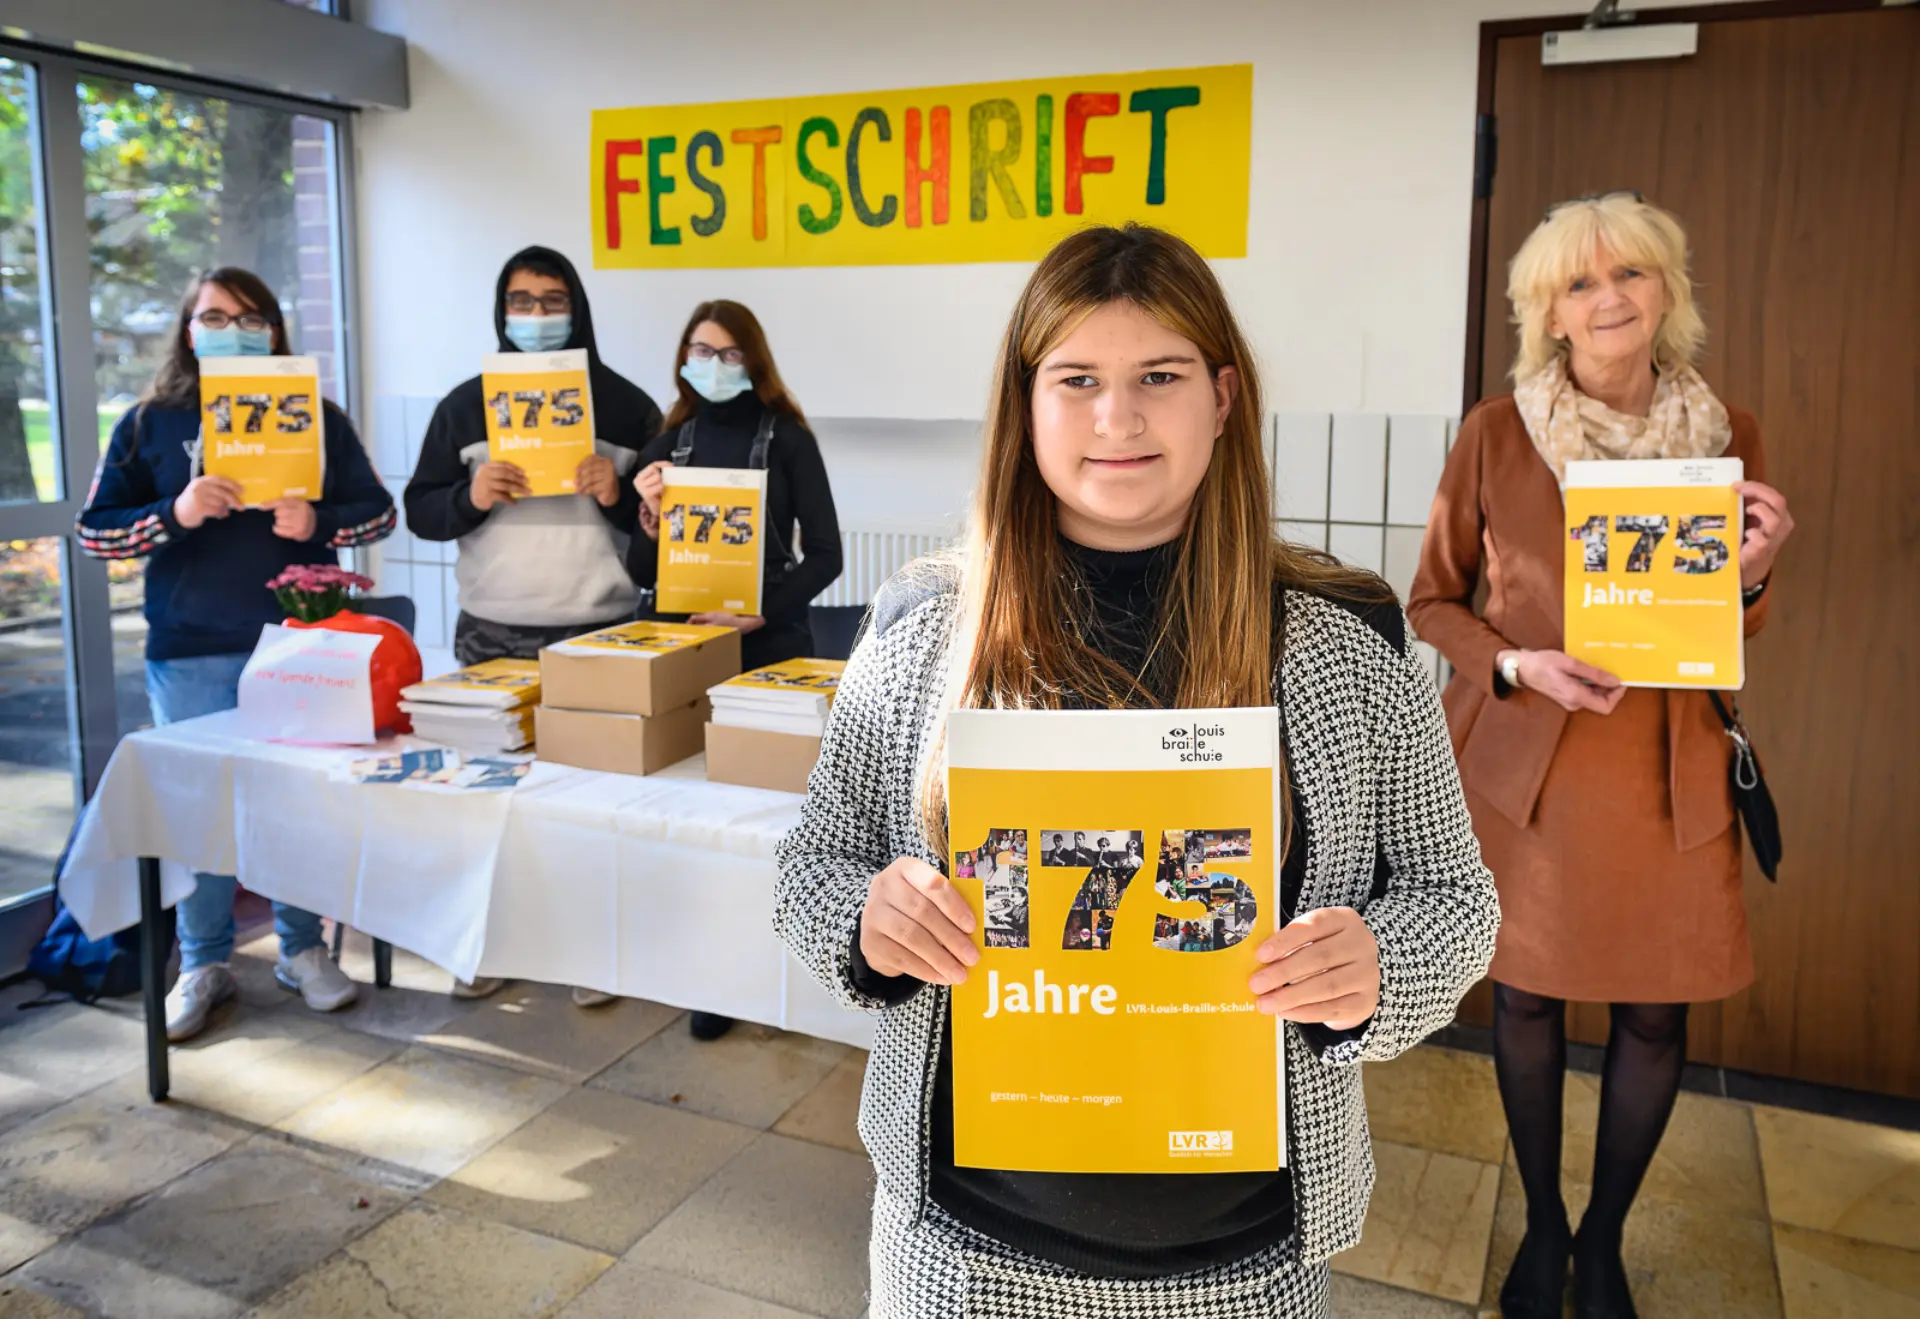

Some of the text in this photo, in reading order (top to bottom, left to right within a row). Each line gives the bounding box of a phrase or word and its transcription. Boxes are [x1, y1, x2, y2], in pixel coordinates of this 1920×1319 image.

[605, 85, 1201, 250] FESTSCHRIFT
[204, 392, 314, 434] 175
[488, 388, 585, 429] 175
[216, 440, 266, 458] Jahre
[499, 435, 544, 453] Jahre
[663, 504, 754, 545] 175
[1569, 515, 1731, 575] 175
[669, 548, 711, 565] Jahre
[1582, 582, 1654, 608] Jahre
[954, 827, 1258, 952] 175
[983, 969, 1256, 1019] Jahre LVR-Louis-Braille-Schule
[990, 1092, 1028, 1103] gestern
[1039, 1091, 1070, 1104] heute
[1082, 1094, 1123, 1107] morgen
[1171, 1134, 1208, 1148] LVR
